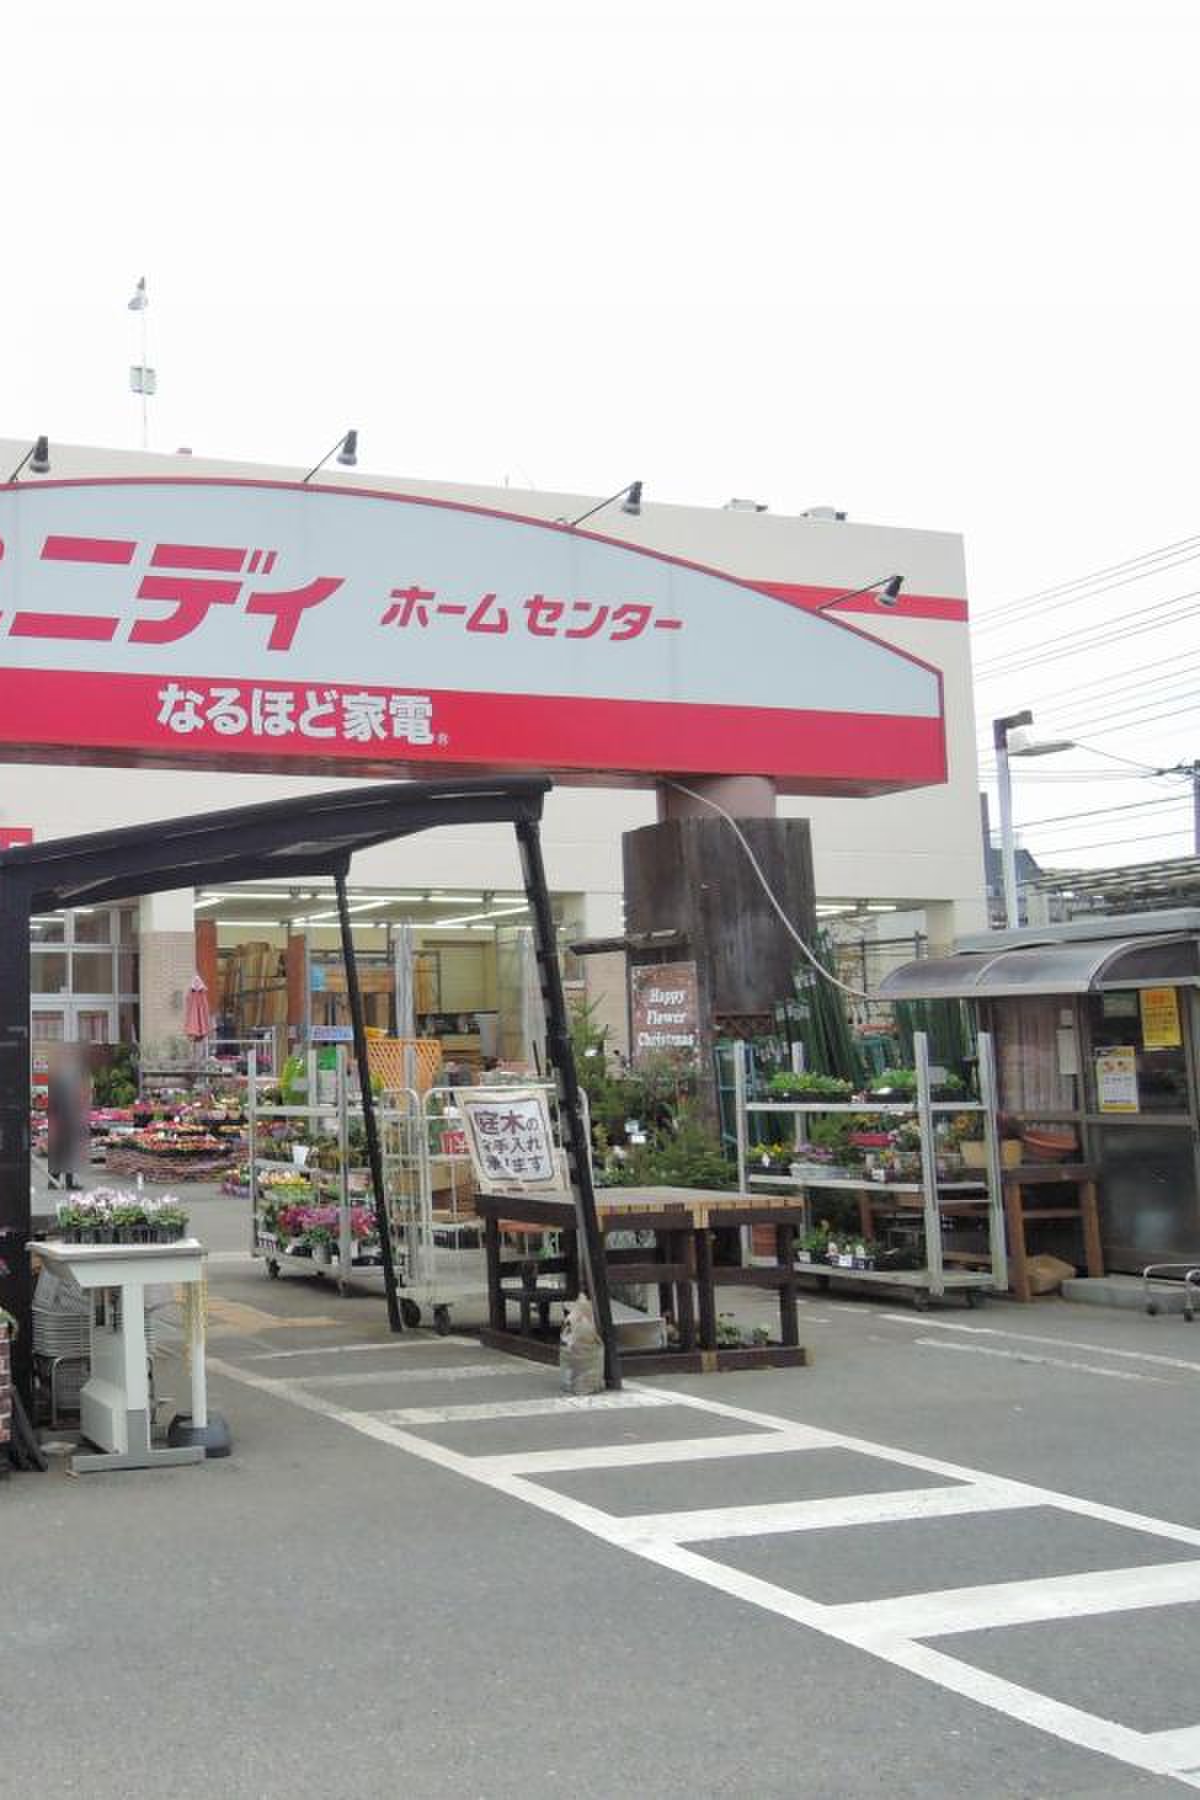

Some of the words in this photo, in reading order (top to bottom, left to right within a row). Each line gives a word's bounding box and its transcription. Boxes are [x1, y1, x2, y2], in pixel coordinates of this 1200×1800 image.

[380, 586, 683, 641] ホームセンター
[157, 683, 434, 745] なるほど家電
[649, 988, 685, 1006] Happy
[474, 1110, 539, 1135] 庭木の
